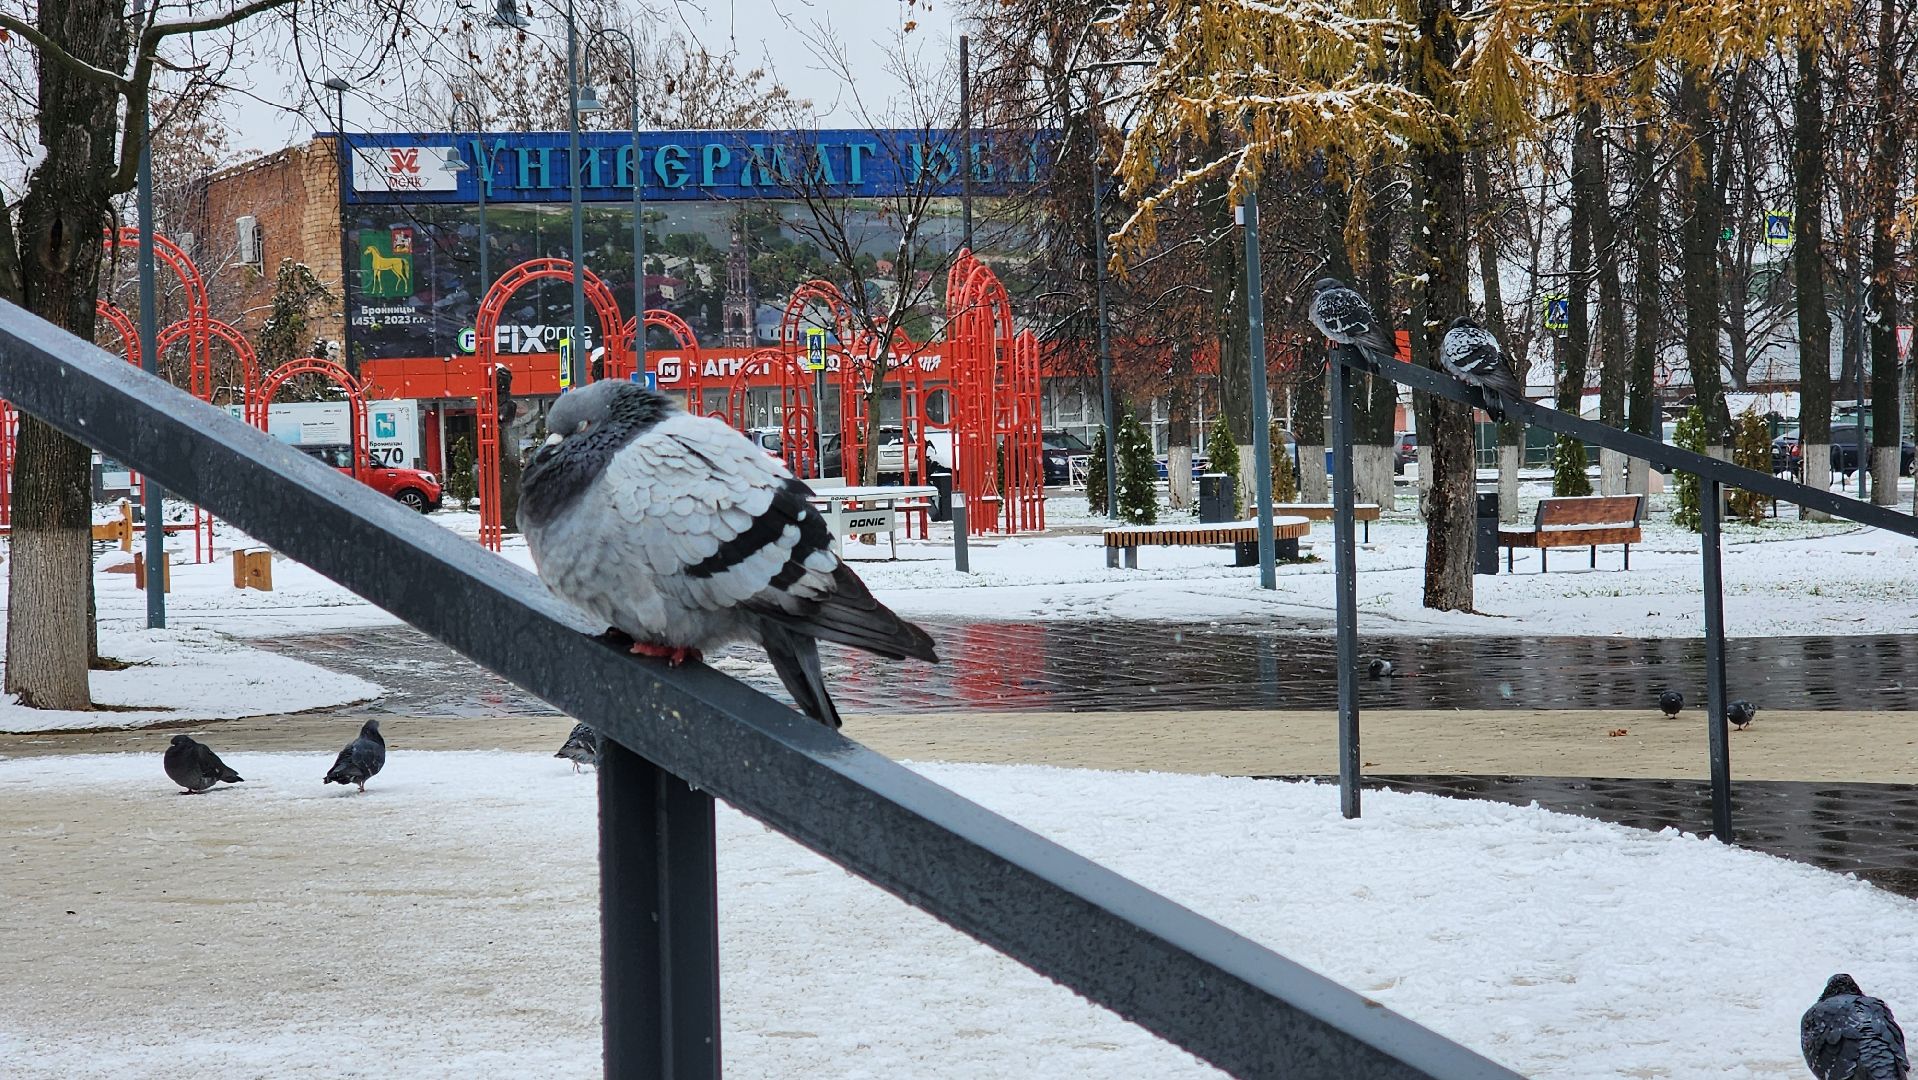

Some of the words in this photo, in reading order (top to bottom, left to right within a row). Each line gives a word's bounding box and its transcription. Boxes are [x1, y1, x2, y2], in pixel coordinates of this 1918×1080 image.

[361, 305, 416, 316] Бронницы
[384, 315, 411, 325] 2023
[369, 447, 404, 465] 570
[849, 517, 886, 528] DONIC
